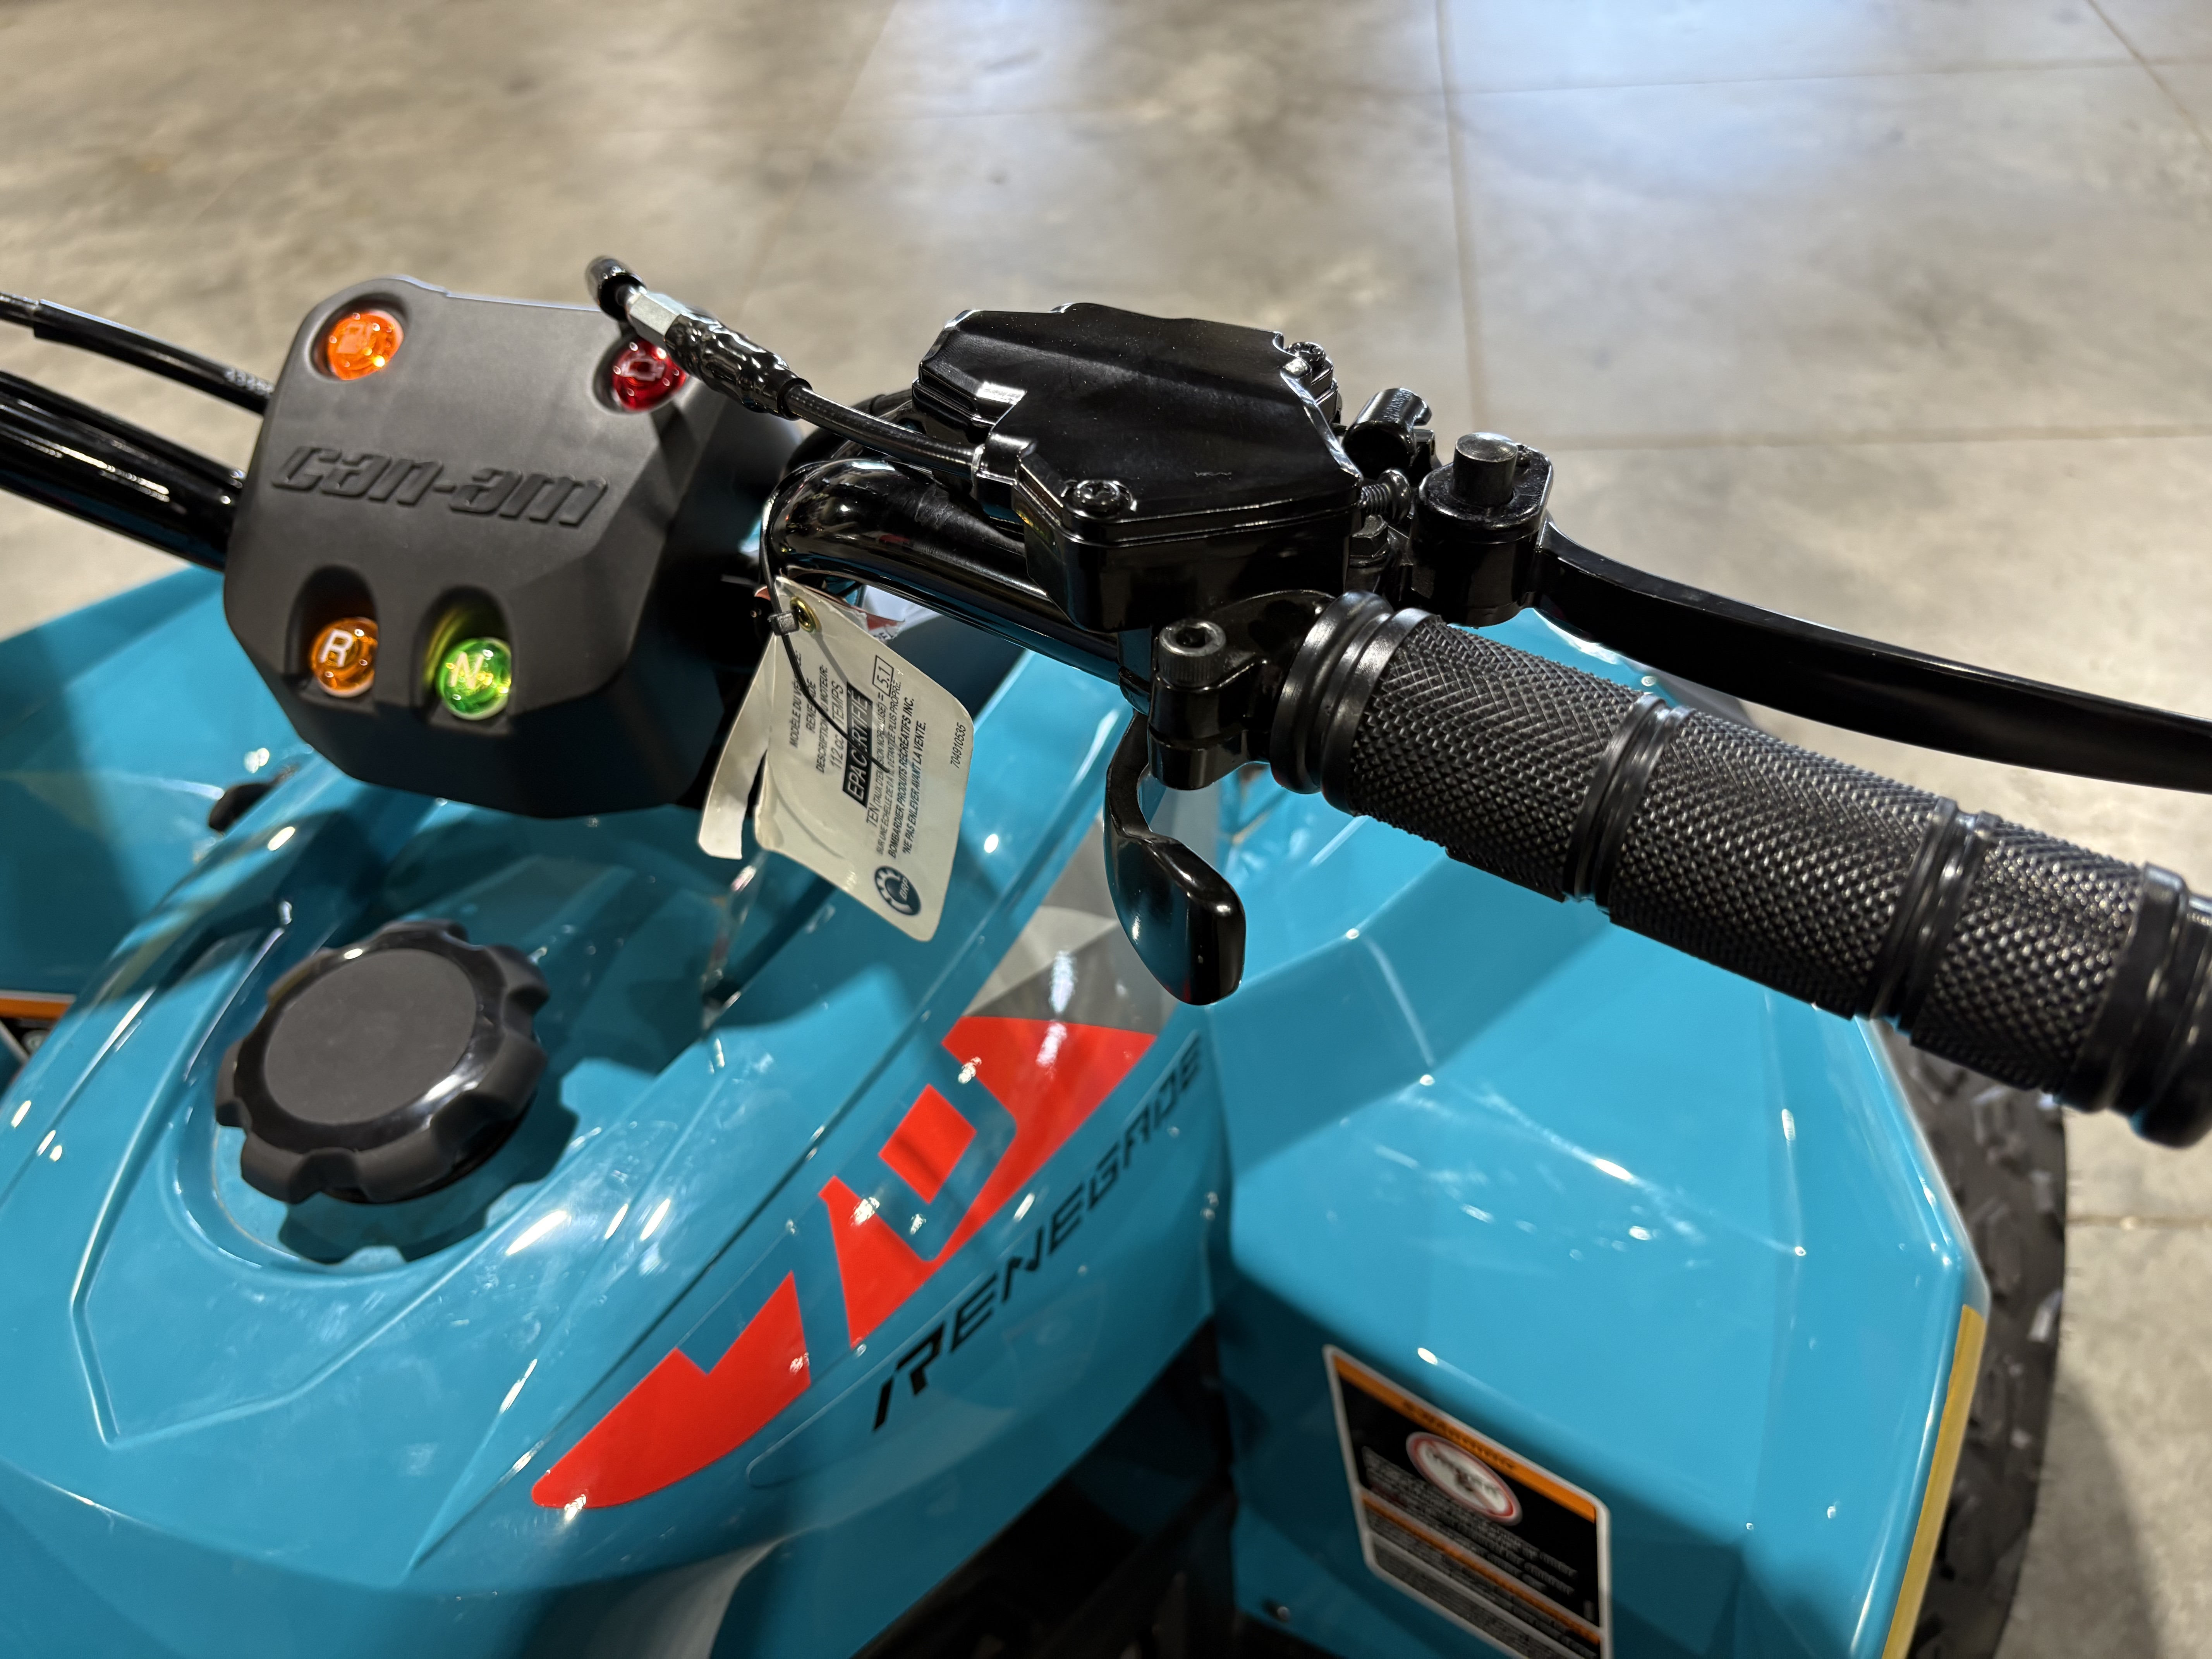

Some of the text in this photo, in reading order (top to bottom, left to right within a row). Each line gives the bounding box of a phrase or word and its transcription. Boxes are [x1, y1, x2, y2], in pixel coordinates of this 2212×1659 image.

[271, 445, 609, 527] can-am
[319, 628, 354, 667] R
[448, 651, 484, 689] N
[819, 665, 828, 704] MOTEUR:
[876, 666, 890, 688] 5.1
[793, 697, 802, 711] DU
[805, 678, 816, 732] RENEADE
[832, 680, 844, 725] TEMPS
[789, 711, 800, 748] MODÈLE
[888, 712, 897, 733] PLUS
[888, 731, 895, 742] LE
[914, 720, 926, 751] VENTE.
[830, 748, 843, 769] 112
[848, 690, 868, 801] EPA CRTIFIÉ
[912, 751, 922, 765] LA
[950, 722, 966, 768] 704910535
[885, 785, 893, 797] DE
[888, 697, 914, 858] BOMBARDIER PRODUITS RÉCRÉATIFS INC.
[911, 762, 921, 791] AVANT
[872, 783, 883, 807] (TAUX
[907, 787, 920, 825] ENLEVER
[866, 802, 879, 827] TEN
[879, 825, 888, 840] UNE
[905, 823, 915, 842] PAS
[873, 1035, 1203, 1432] RENEGADE
